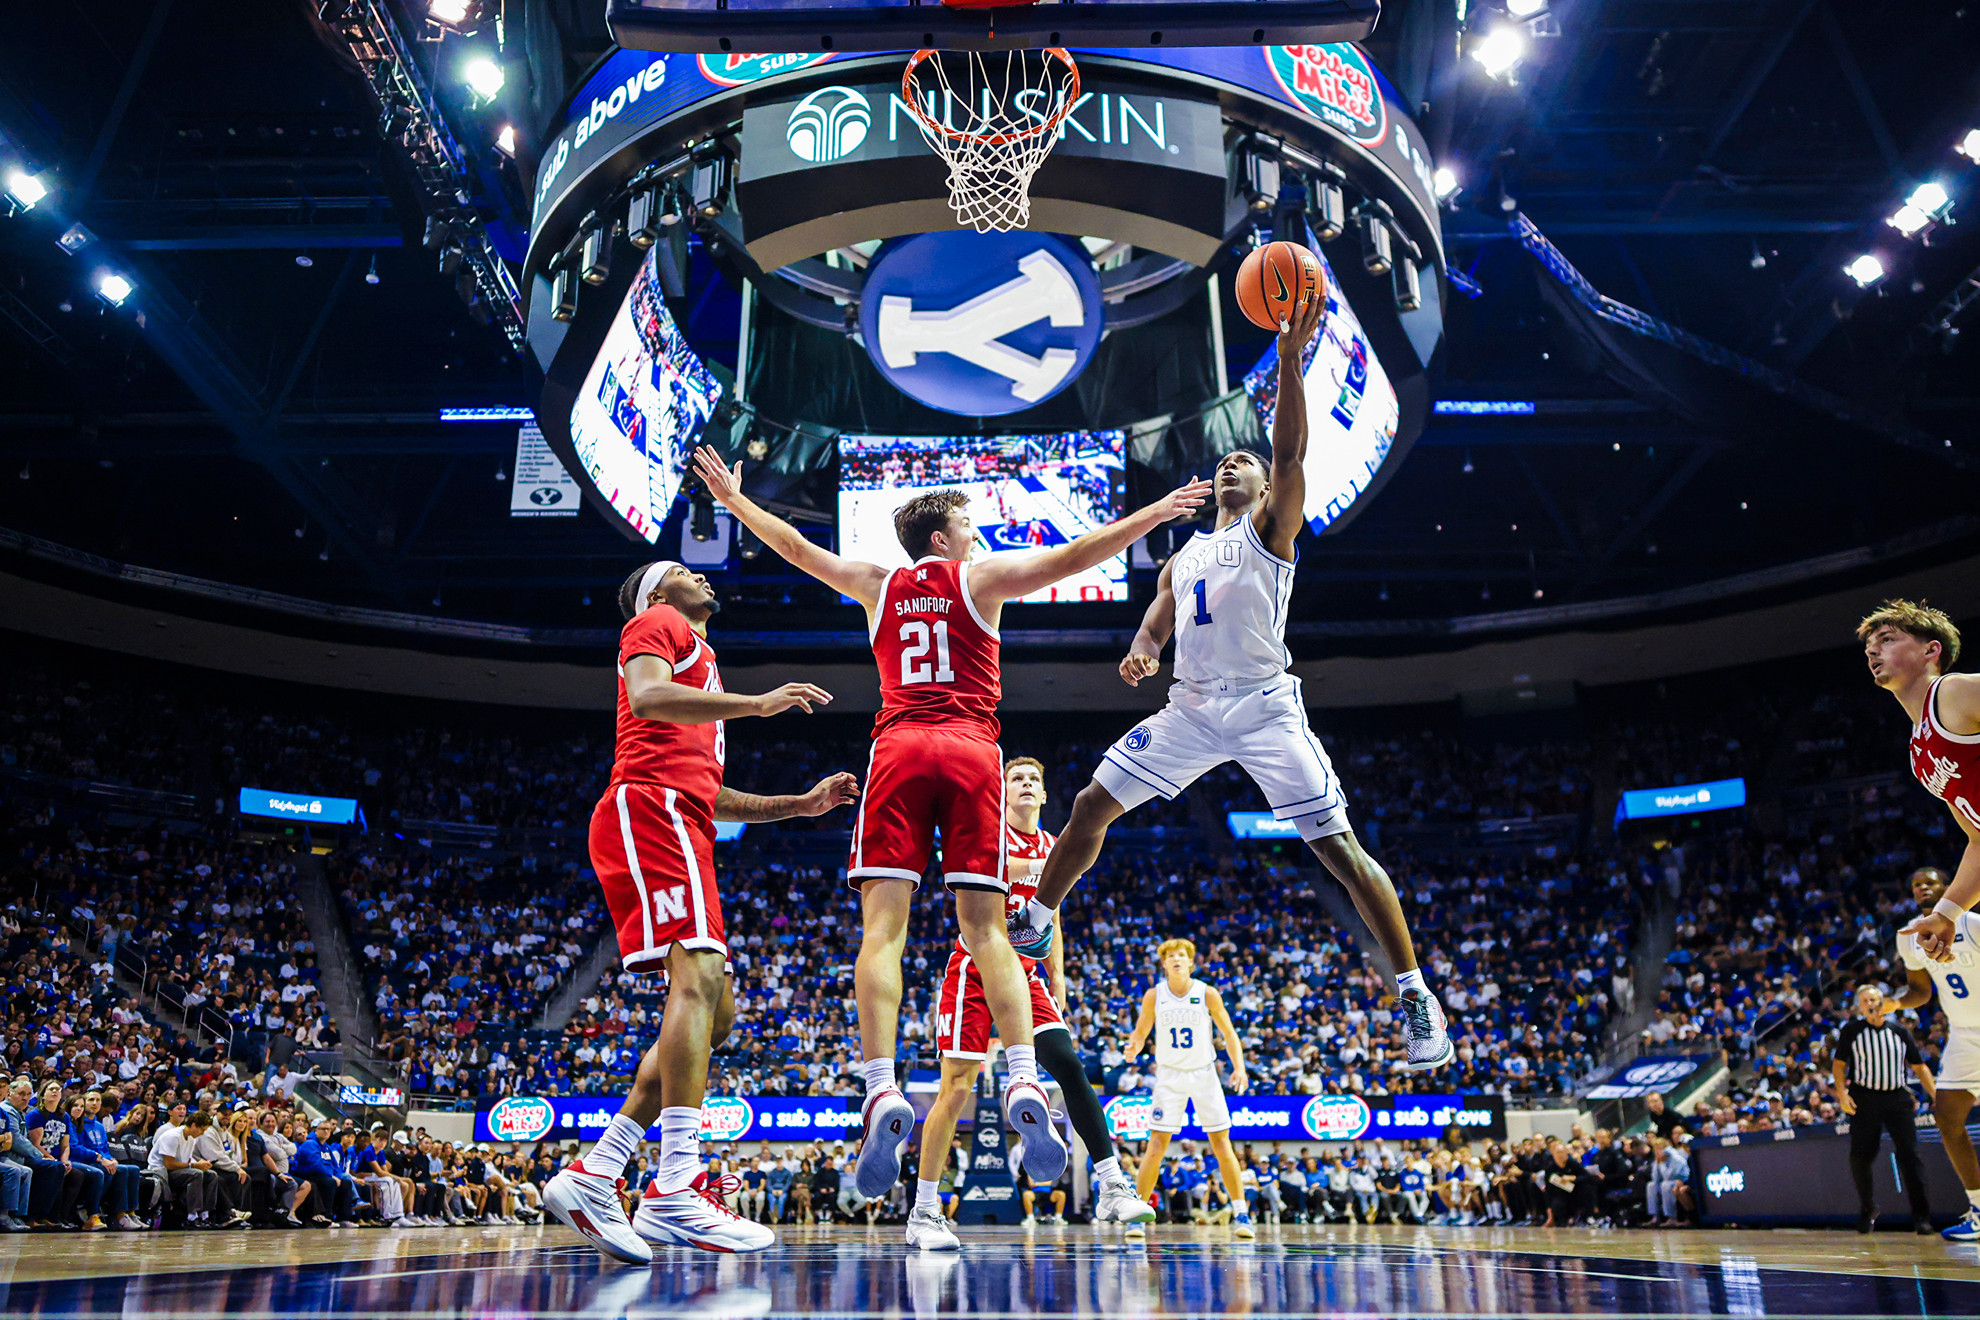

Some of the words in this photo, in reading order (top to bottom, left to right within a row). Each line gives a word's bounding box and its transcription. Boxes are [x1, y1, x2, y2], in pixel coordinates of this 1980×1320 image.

[760, 51, 810, 74] SUBS
[540, 137, 570, 204] sub
[574, 59, 667, 150] above
[1321, 106, 1358, 134] SUBS
[879, 249, 1085, 403] Y
[1174, 539, 1243, 583] BYU
[916, 568, 928, 582] N
[894, 596, 953, 616] SANDFORT
[1193, 578, 1213, 627] 1
[899, 619, 955, 686] 21
[653, 884, 688, 926] N
[1922, 950, 1975, 973] BU
[1945, 973, 1970, 999] 9
[1170, 1027, 1194, 1049] 13
[498, 1105, 545, 1119] Jersey
[561, 1112, 574, 1128] a
[577, 1108, 612, 1128] sub
[759, 1112, 773, 1127] a
[776, 1107, 811, 1127] sub
[813, 1108, 864, 1127] abov
[1112, 1102, 1150, 1118] Jerse
[1231, 1107, 1290, 1126] above
[1376, 1109, 1391, 1126] a
[1394, 1106, 1429, 1126] sub
